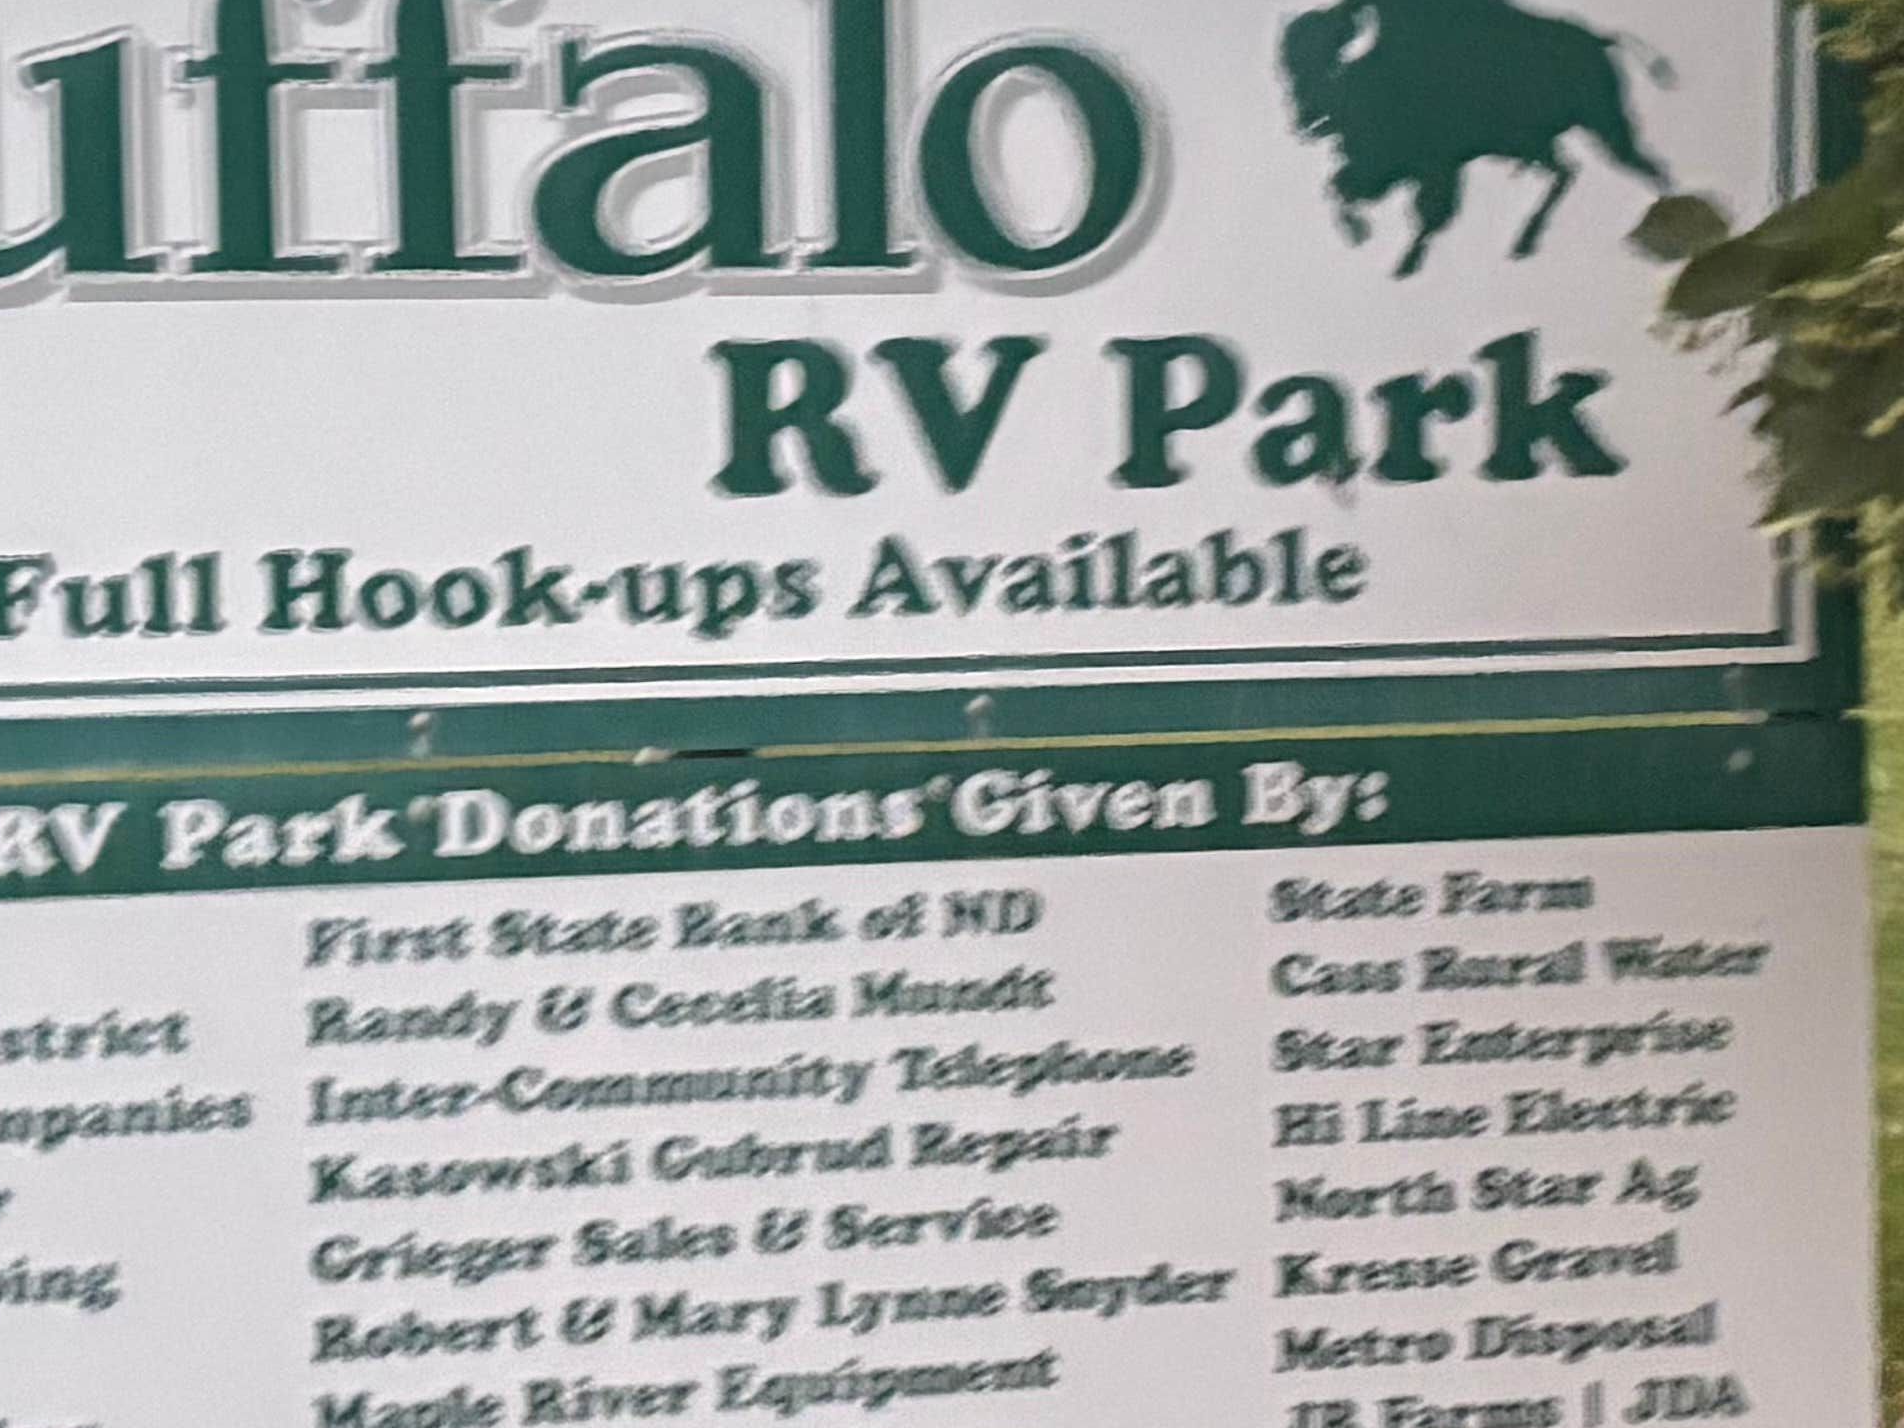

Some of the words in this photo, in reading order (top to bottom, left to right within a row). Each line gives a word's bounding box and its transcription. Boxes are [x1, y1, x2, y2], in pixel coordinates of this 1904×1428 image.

[712, 332, 1049, 500] RV
[1105, 325, 1626, 491] Park
[260, 536, 817, 643] Hook-ups
[847, 528, 1367, 621] Available
[160, 792, 402, 871] Park
[436, 778, 920, 860] Donations
[951, 767, 1215, 837] Given
[1242, 761, 1387, 840] By:
[305, 914, 473, 969] First
[490, 904, 660, 958] State
[672, 900, 846, 950] Bank
[859, 894, 927, 942] of
[941, 889, 1044, 937] ND
[1270, 877, 1426, 924] State
[1440, 871, 1595, 914] Farm
[1271, 953, 1402, 996] Cass
[1418, 940, 1586, 990] Rural
[1602, 935, 1773, 981] Water
[306, 992, 519, 1048] Randy
[535, 984, 594, 1034] &
[1271, 1028, 1404, 1071] Star
[1418, 1010, 1735, 1066] Enterprise
[306, 1051, 874, 1126] Inter-Community
[893, 1042, 1196, 1098] Telephone
[1273, 1102, 1344, 1148] Hi
[1357, 1096, 1492, 1143] Line
[1503, 1081, 1738, 1136] Electric
[908, 1115, 1118, 1173] Repair
[1274, 1172, 1457, 1222] North
[1472, 1166, 1604, 1212] Star
[1615, 1154, 1701, 1211] Ag
[573, 1217, 738, 1270] Sales
[752, 1208, 810, 1256] &
[824, 1198, 1062, 1253] Service
[1490, 1229, 1682, 1283] Gravel
[312, 1312, 544, 1364] Robert
[560, 1298, 616, 1347] &
[632, 1292, 799, 1344] Mary
[1024, 1264, 1238, 1317] Snyder
[1274, 1327, 1453, 1373] Metro
[1465, 1300, 1721, 1364] Disposal
[521, 1375, 699, 1428] River
[716, 1351, 1062, 1419] Equipment
